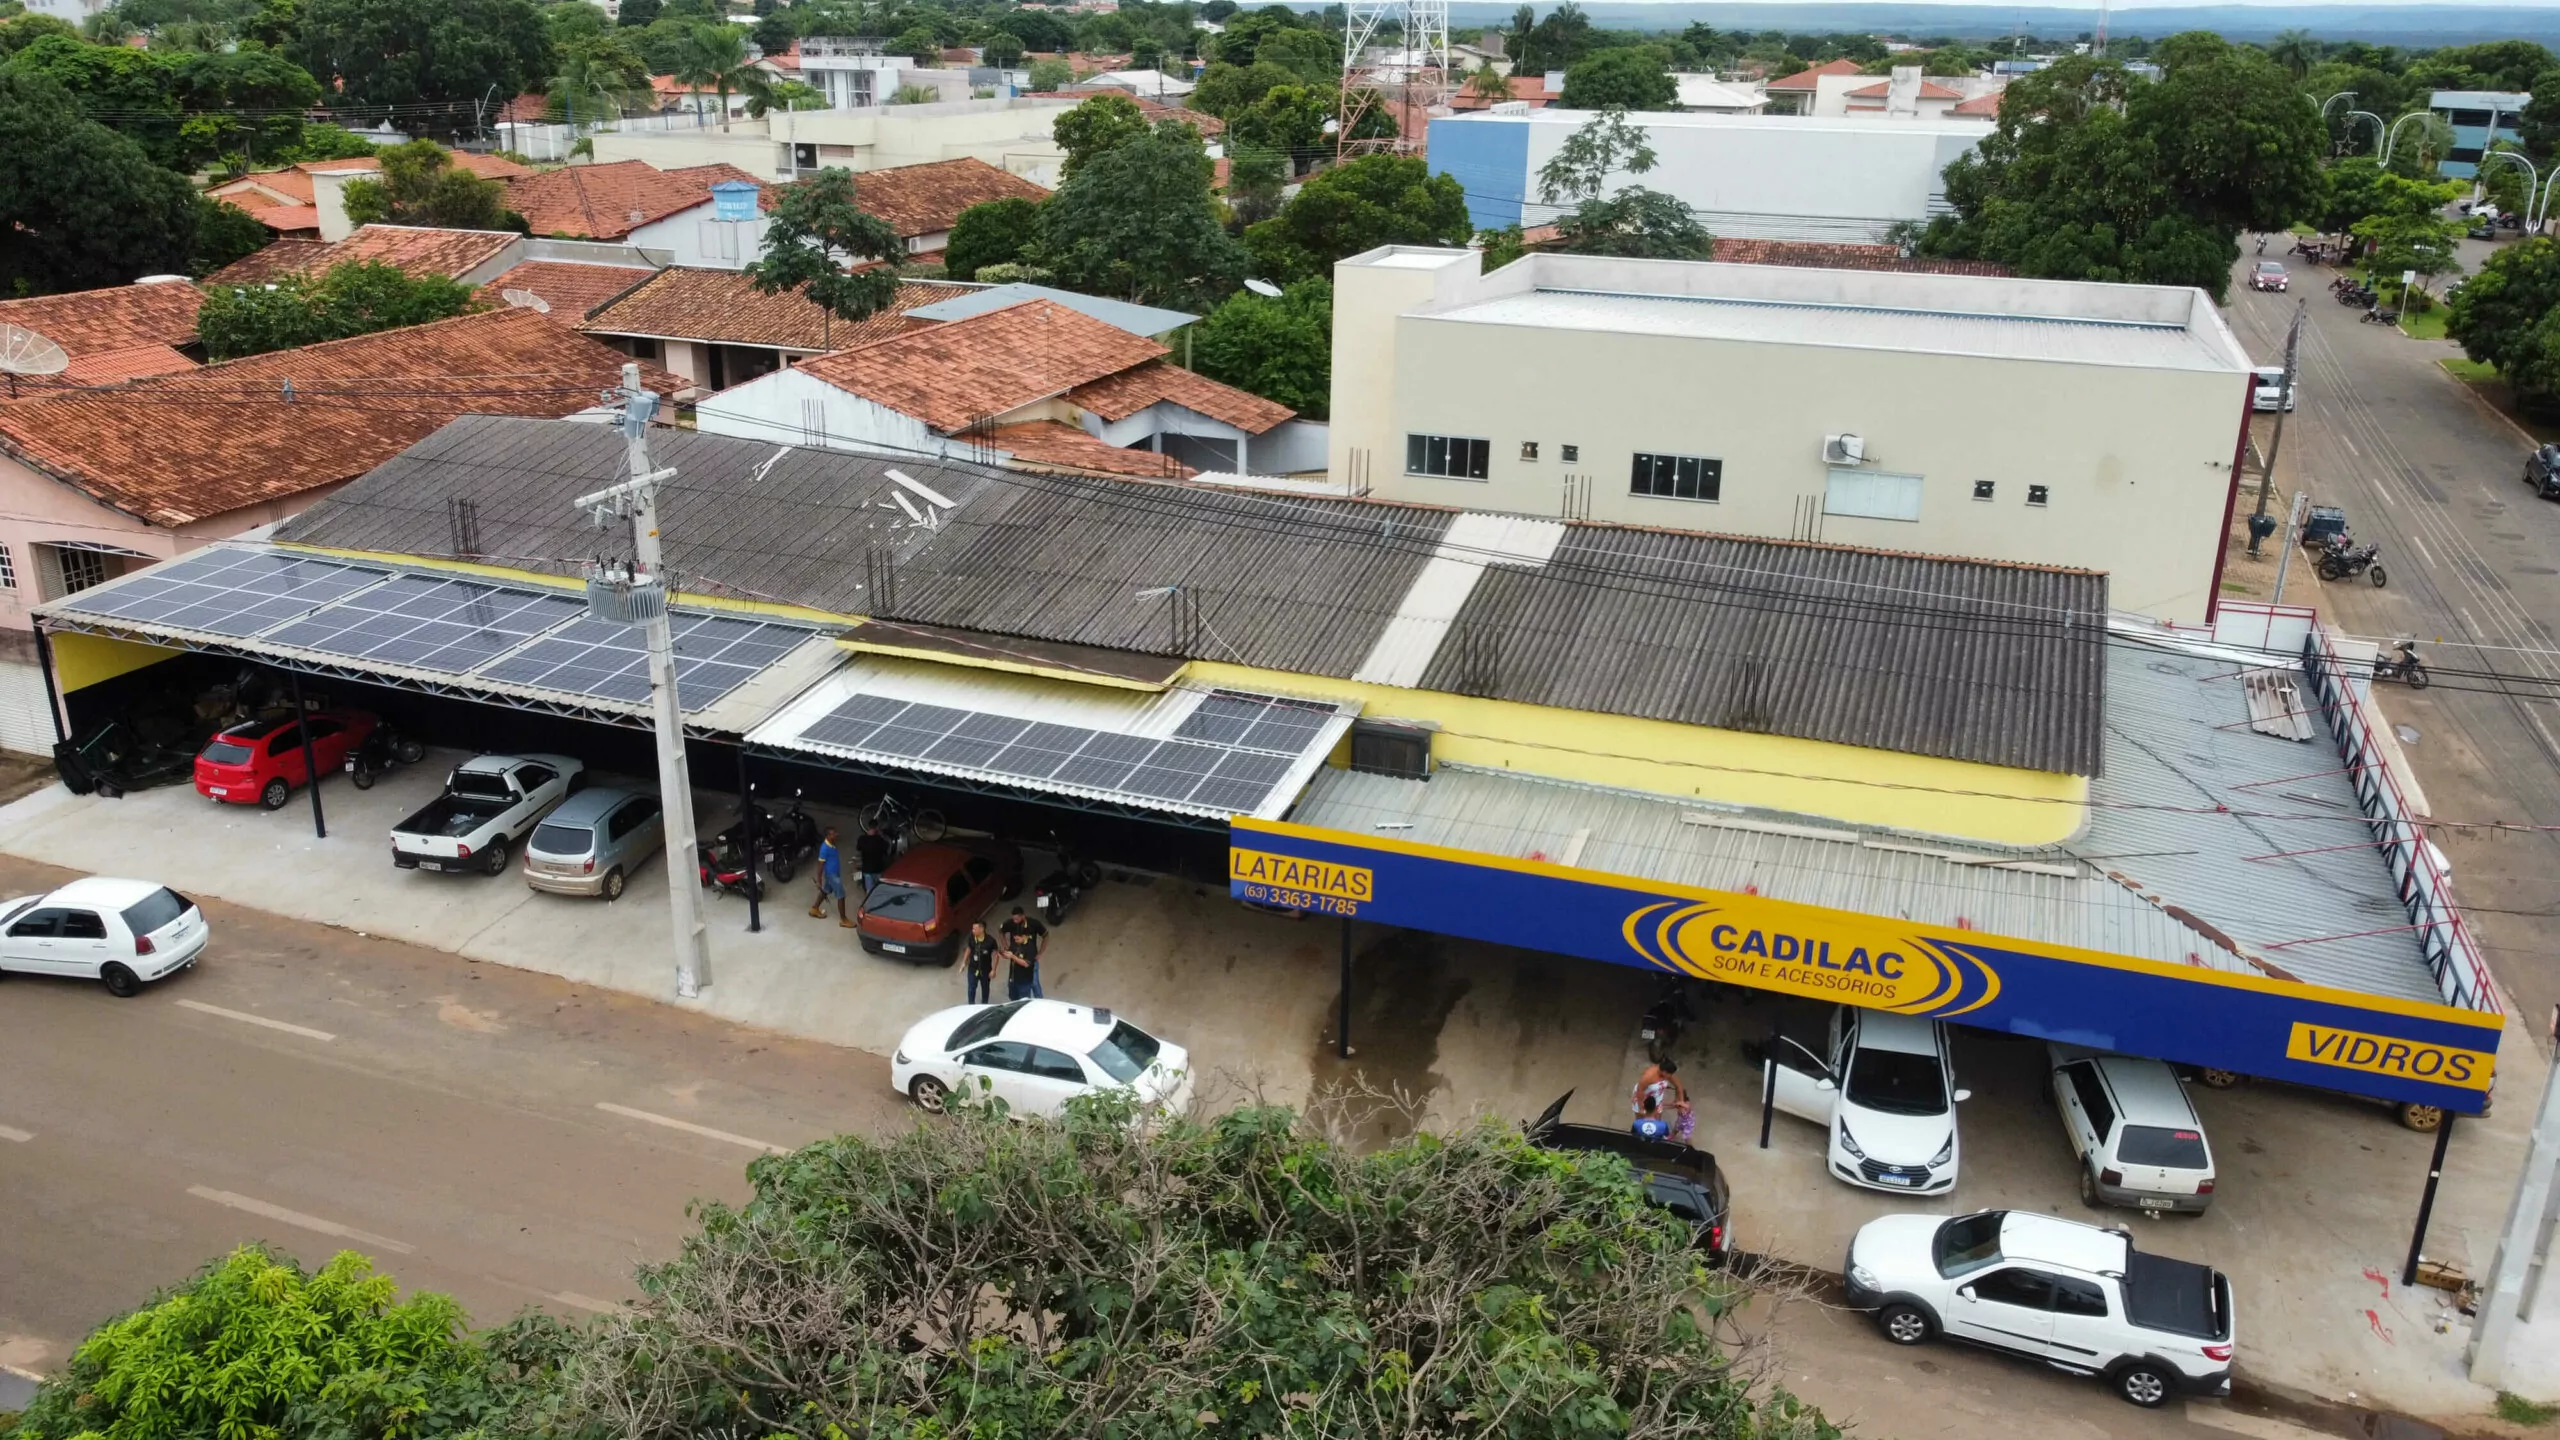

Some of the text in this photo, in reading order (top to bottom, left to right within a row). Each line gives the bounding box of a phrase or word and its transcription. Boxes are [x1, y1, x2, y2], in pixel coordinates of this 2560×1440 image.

[1234, 853, 1368, 896] LATARIAS
[1244, 884, 1358, 916] (63) 3363-1785
[1710, 924, 1905, 980] CADILAC
[1712, 955, 1897, 999] SOM E ACESSÓRIOS
[2308, 1029, 2476, 1081] VIDROS
